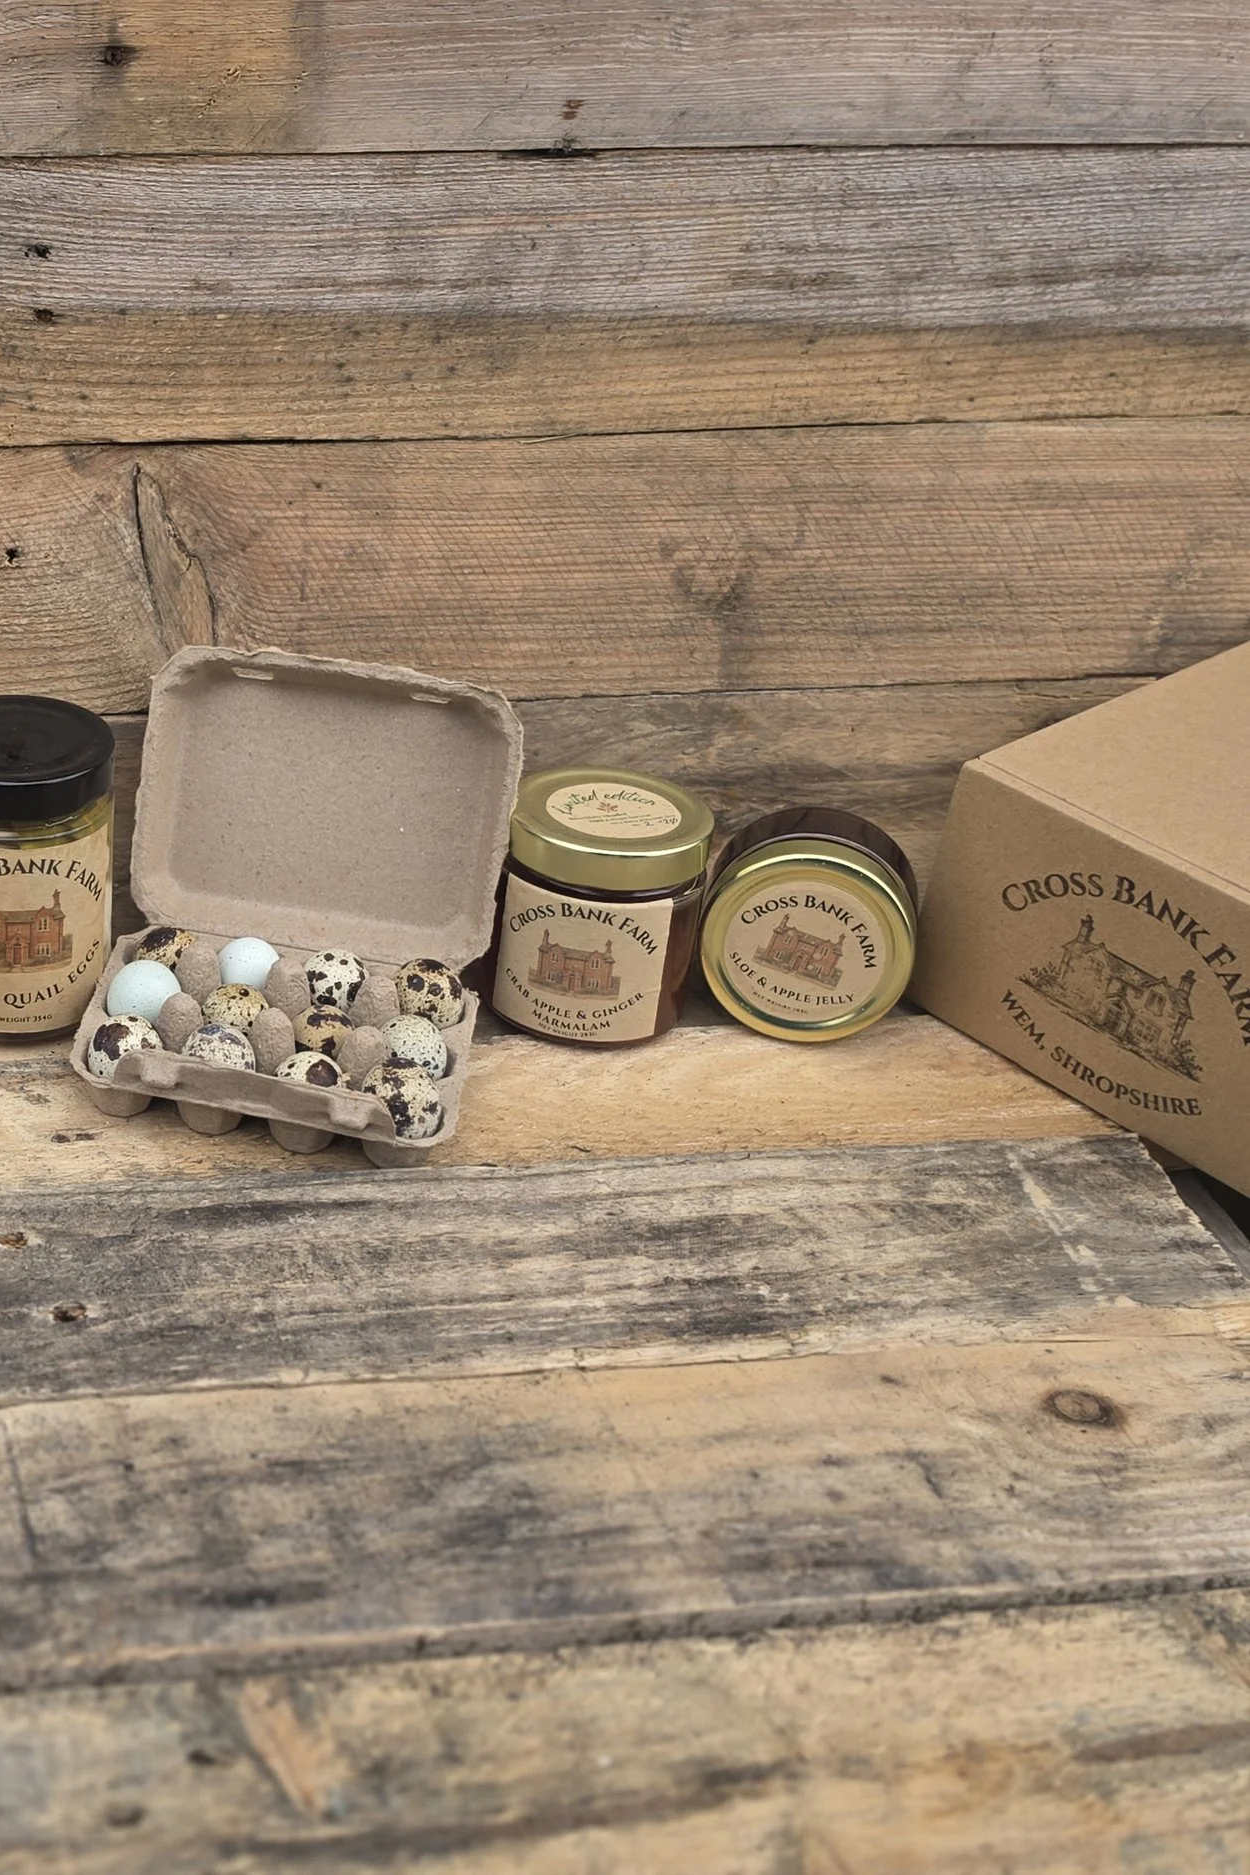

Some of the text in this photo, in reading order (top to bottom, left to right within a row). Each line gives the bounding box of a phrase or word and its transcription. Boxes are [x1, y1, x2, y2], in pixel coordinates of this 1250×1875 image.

[65, 860, 103, 902] FARM
[509, 903, 658, 956] CROSS BANK FARM
[740, 895, 878, 969] CROSS BANK FARM
[1001, 872, 1104, 912] CROSS
[1111, 874, 1211, 951] BANK
[4, 983, 64, 1009] QUAIL
[67, 938, 100, 985] EGGS
[505, 967, 644, 1020] CRAB APPLE & GINGER
[729, 951, 855, 1006] SLOE & APPLE JELLY
[531, 1009, 611, 1032] MARMALAM
[1001, 989, 1202, 1116] WEM, SHROPSHIRE
